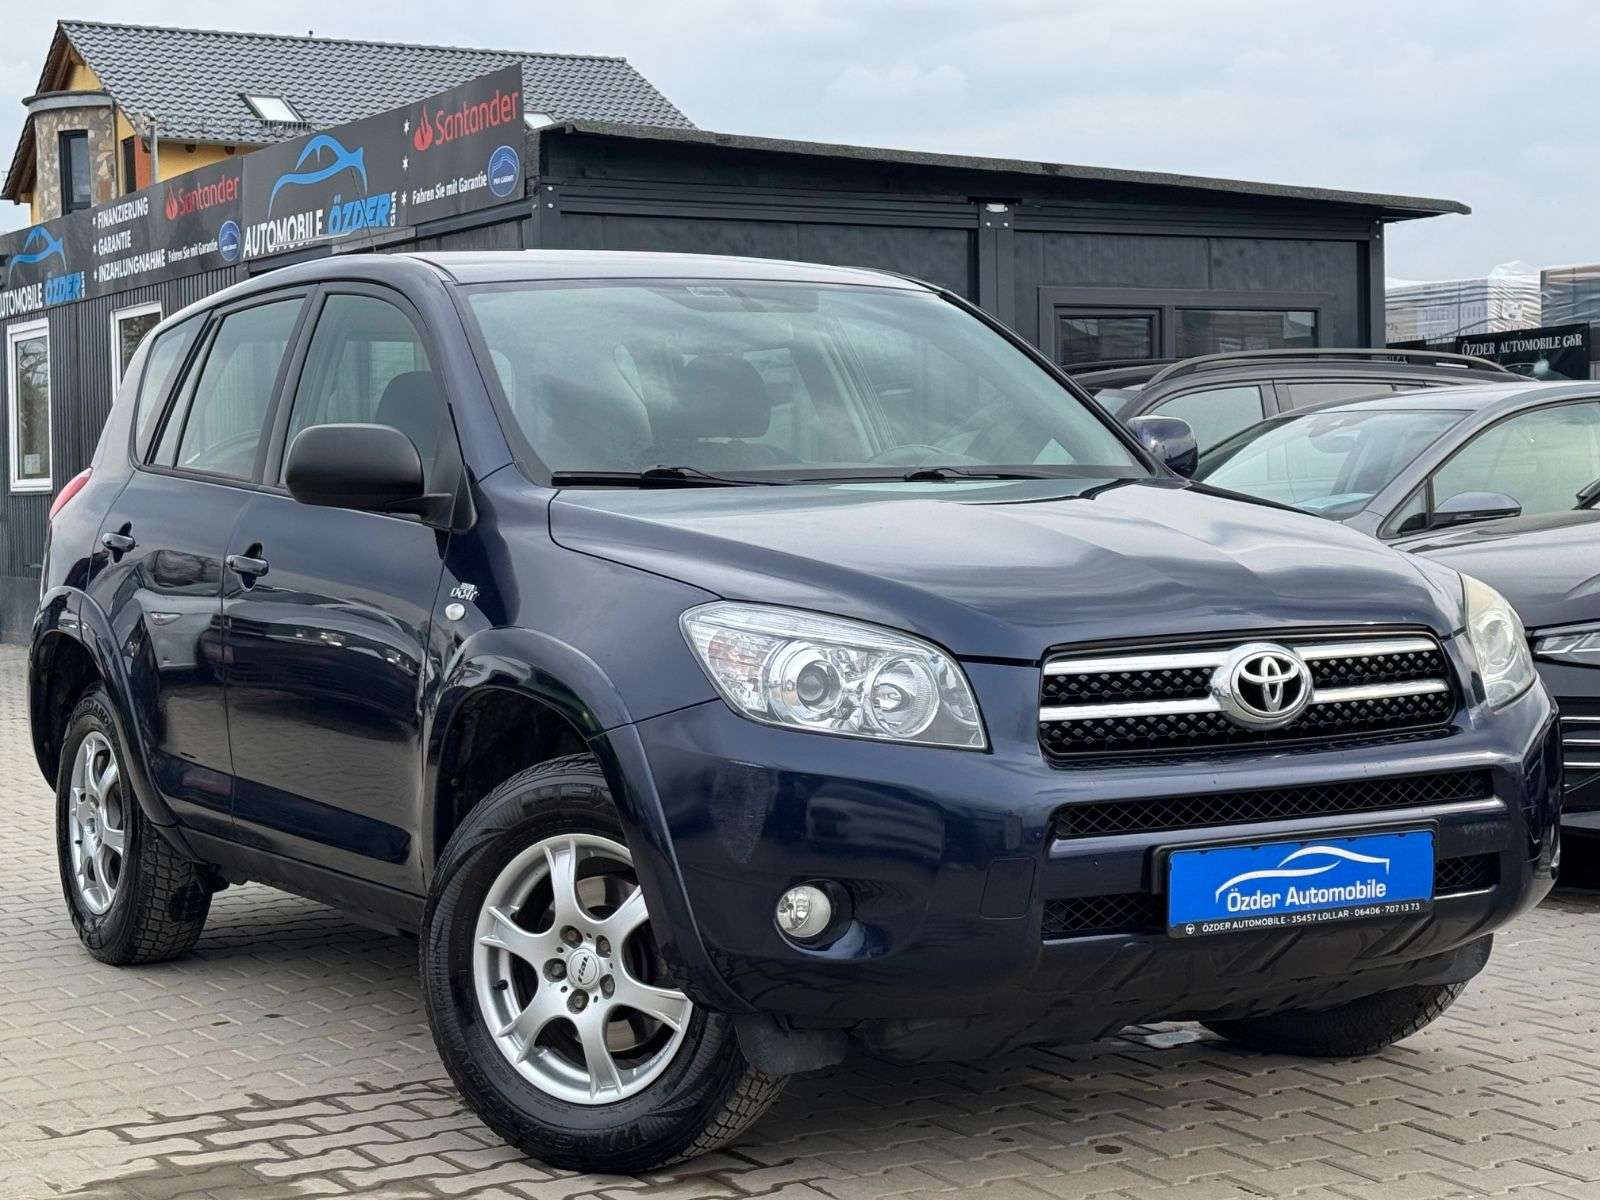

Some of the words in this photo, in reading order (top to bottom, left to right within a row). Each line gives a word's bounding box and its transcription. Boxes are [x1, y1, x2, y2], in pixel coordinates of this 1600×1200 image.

[435, 89, 519, 145] Santander
[177, 175, 240, 217] Santander
[412, 187, 435, 205] Fahren
[435, 182, 445, 199] Sie
[446, 178, 458, 196] mit
[459, 170, 488, 193] Garantie
[97, 196, 149, 230] FINANZIERUNG
[242, 208, 324, 257] AUTOMOBILE
[328, 192, 391, 235] ÖZDER
[98, 229, 132, 257] GARANTIE
[168, 248, 183, 264] Fahren
[199, 237, 218, 255] Garantie
[98, 248, 166, 283] INZAHLUNGNAHME
[0, 282, 43, 319] UTOMOBILE
[1461, 340, 1496, 356] ÖZDER
[1499, 336, 1562, 354] AUTOMOBILE
[1562, 333, 1583, 348] GbR
[1227, 887, 1281, 912] Özder
[1285, 879, 1387, 907] Automobile
[1202, 922, 1231, 933] ÖZDER
[1292, 913, 1318, 924] 35457
[1318, 910, 1349, 921] LOLLAR
[1354, 906, 1381, 917] 06406
[1385, 904, 1400, 913] 707
[1400, 903, 1409, 912] 13
[1411, 902, 1420, 911] 73
